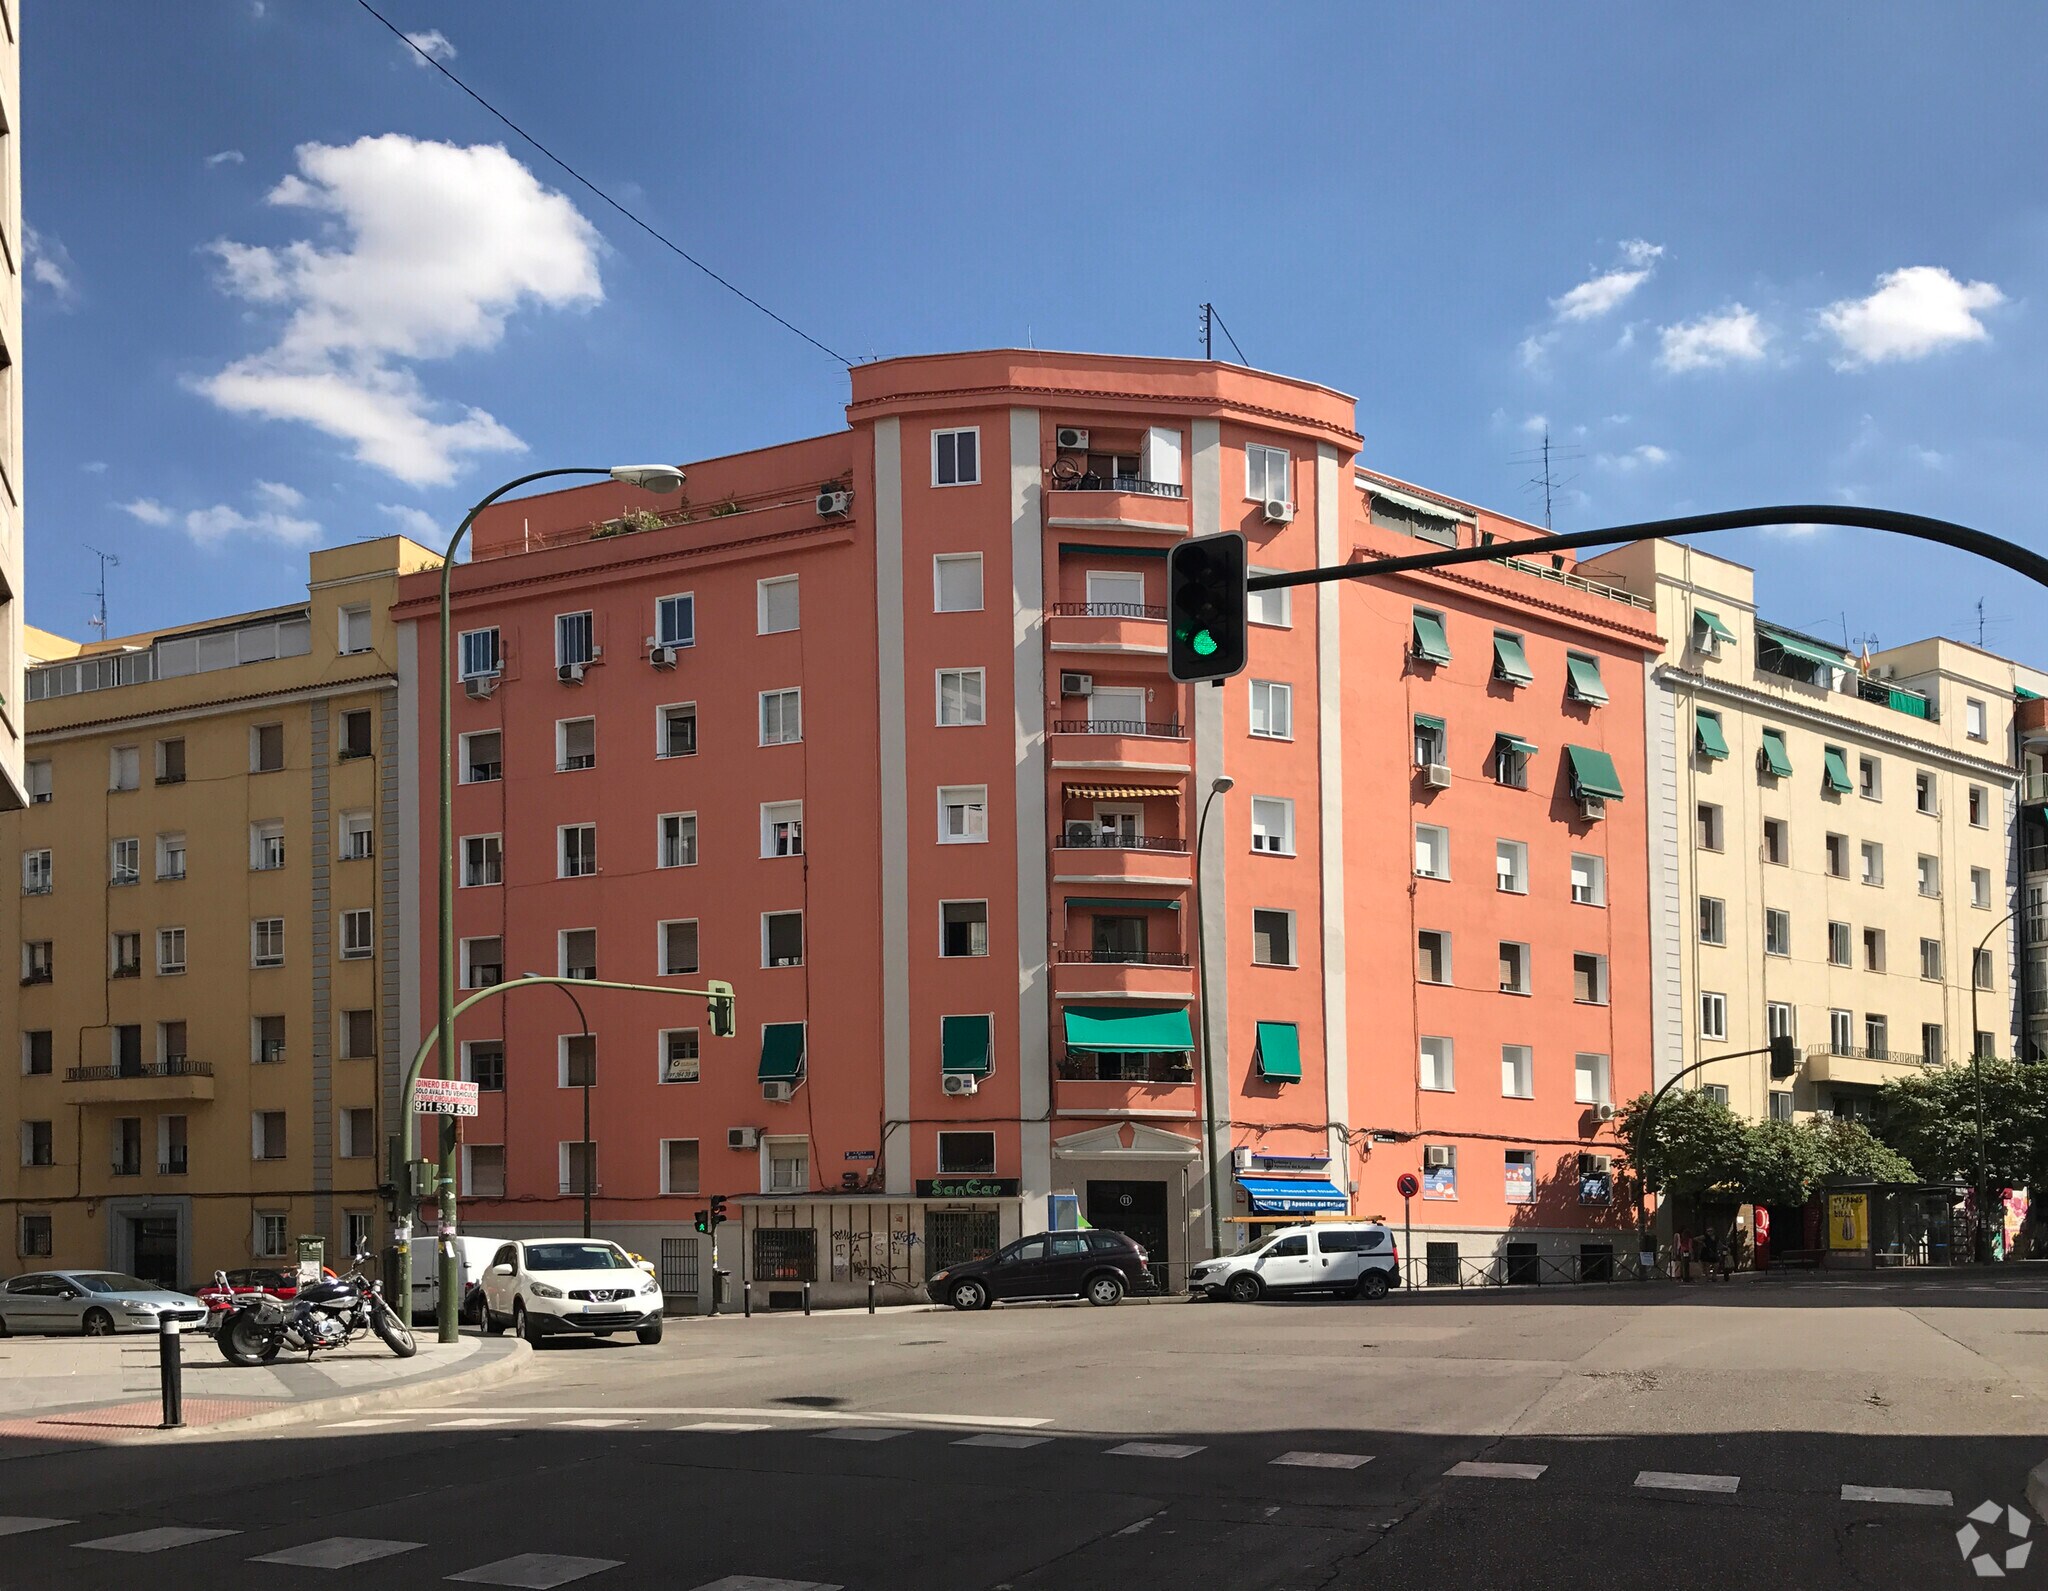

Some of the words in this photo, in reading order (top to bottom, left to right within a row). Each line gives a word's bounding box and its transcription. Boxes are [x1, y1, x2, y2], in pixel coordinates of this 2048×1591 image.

[441, 1081, 450, 1089] EN
[451, 1082, 458, 1090] EL
[429, 1088, 444, 1096] AVALA
[415, 1101, 433, 1111] 911
[436, 1102, 454, 1113] 530
[457, 1104, 475, 1115] 530
